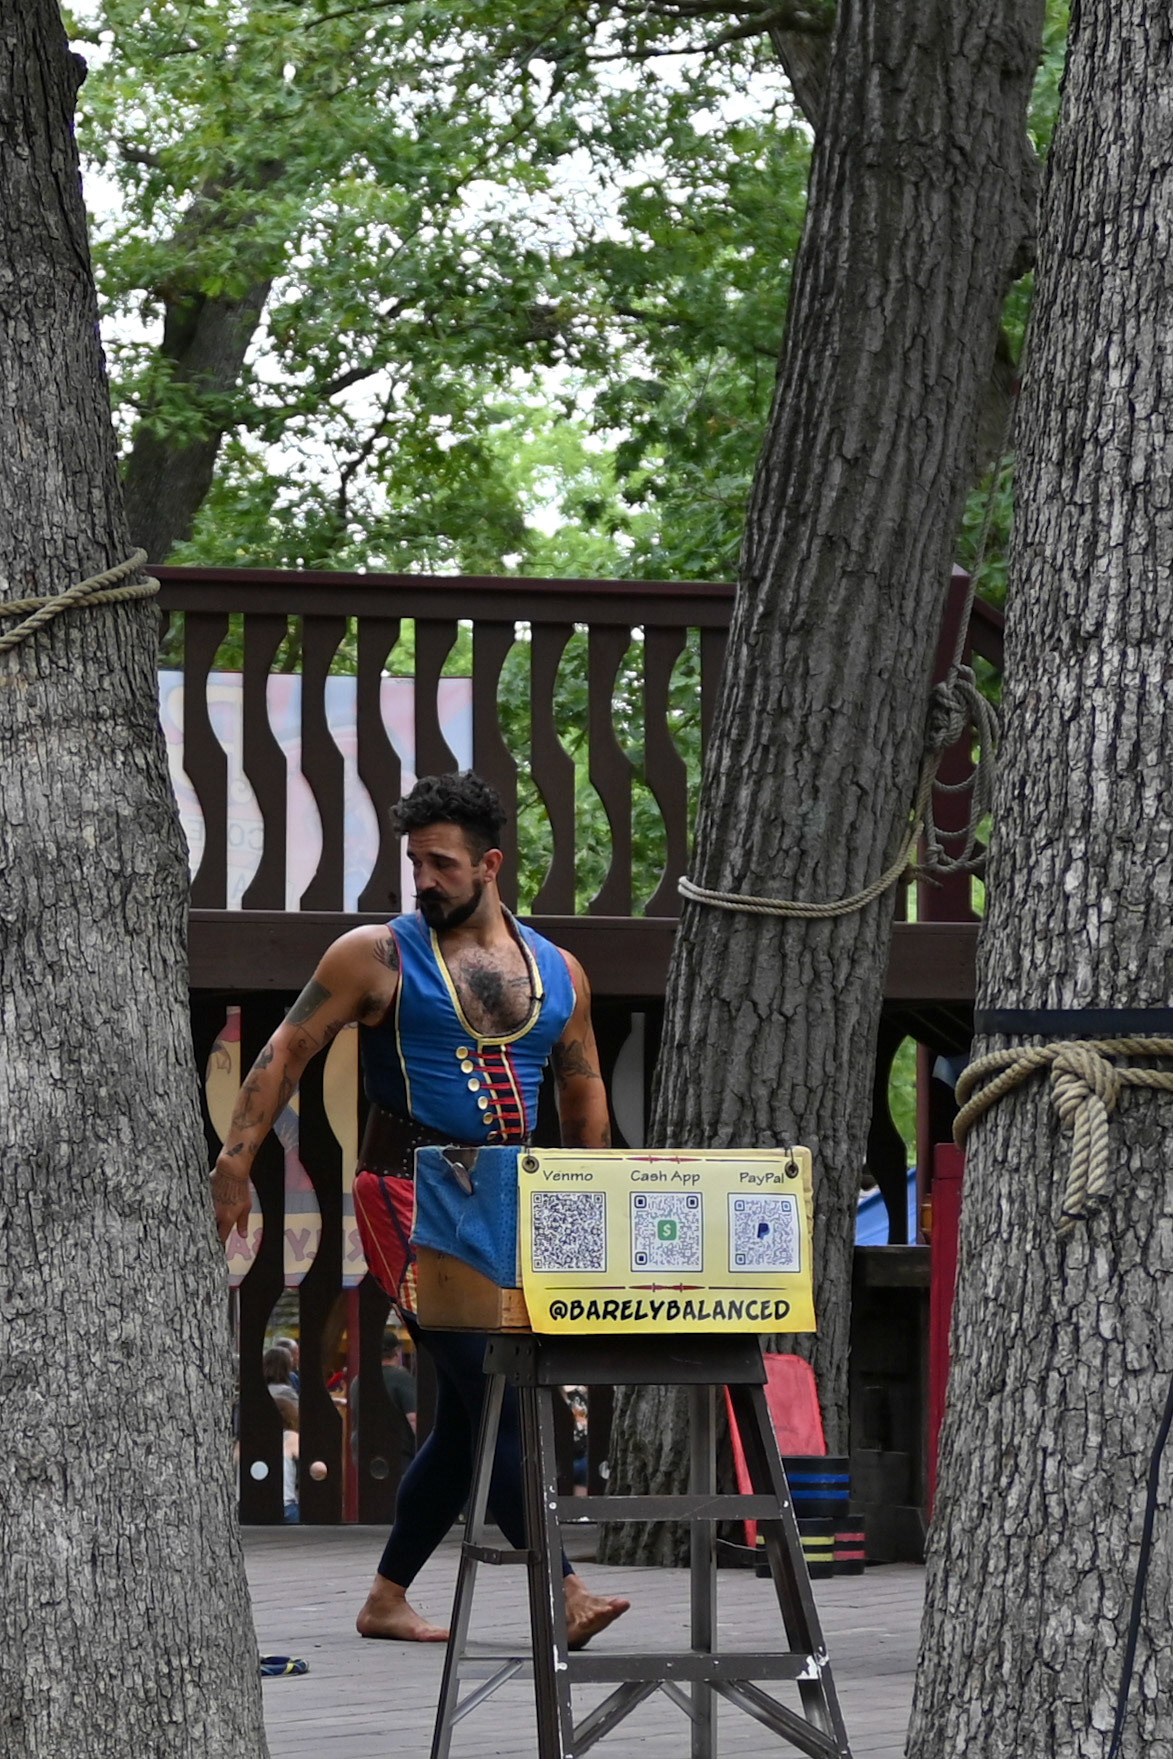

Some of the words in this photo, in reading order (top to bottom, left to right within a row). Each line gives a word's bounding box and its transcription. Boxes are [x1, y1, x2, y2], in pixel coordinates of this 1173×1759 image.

[543, 1170, 593, 1182] Venmo
[631, 1170, 667, 1182] Cash
[670, 1170, 701, 1186] App
[739, 1172, 785, 1185] PayPal
[549, 1300, 790, 1321] @BARELYBALANCED
